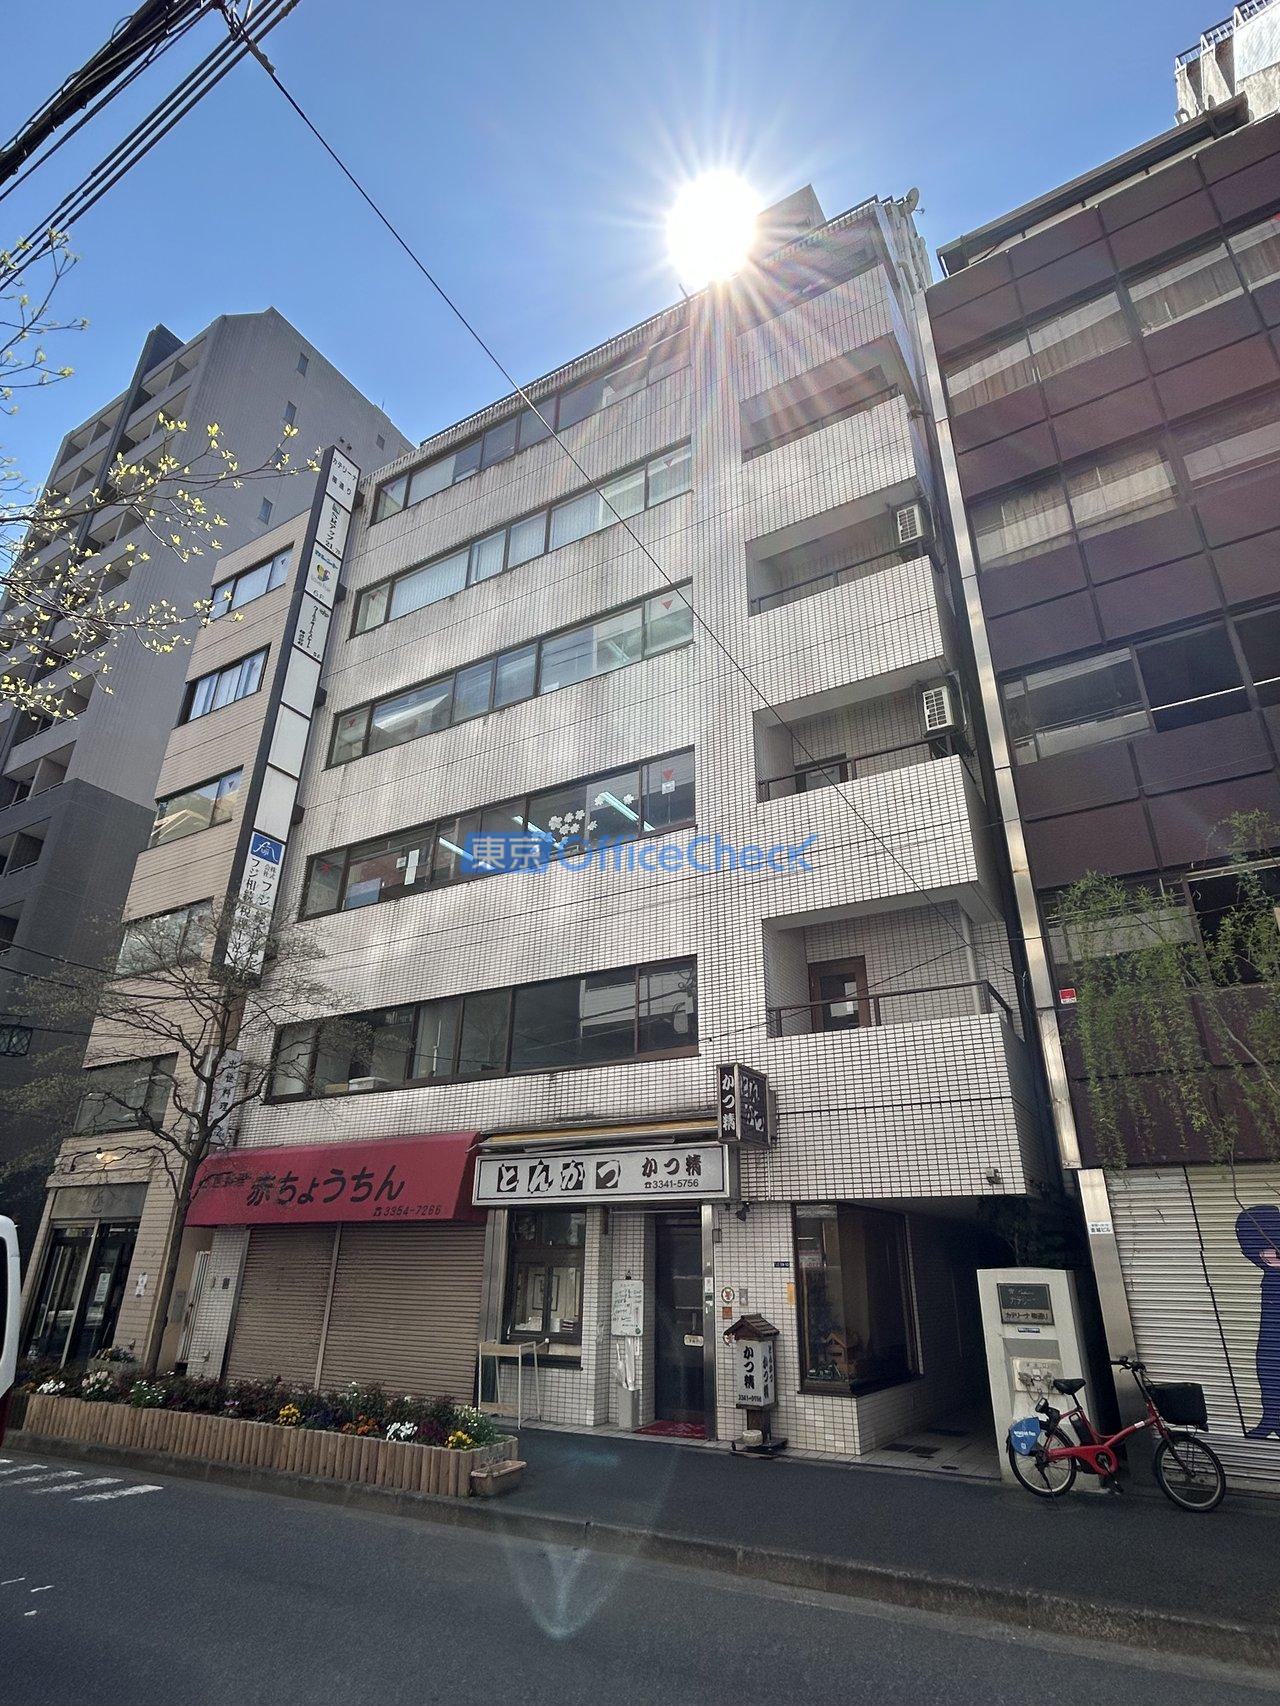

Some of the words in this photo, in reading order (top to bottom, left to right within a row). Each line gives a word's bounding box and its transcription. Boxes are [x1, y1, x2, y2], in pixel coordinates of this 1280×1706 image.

[247, 1165, 405, 1206] 赤ちょうちん
[497, 1160, 621, 1194] とんかつ
[642, 1154, 701, 1177] かつ精
[653, 1179, 699, 1189] 3341-5756
